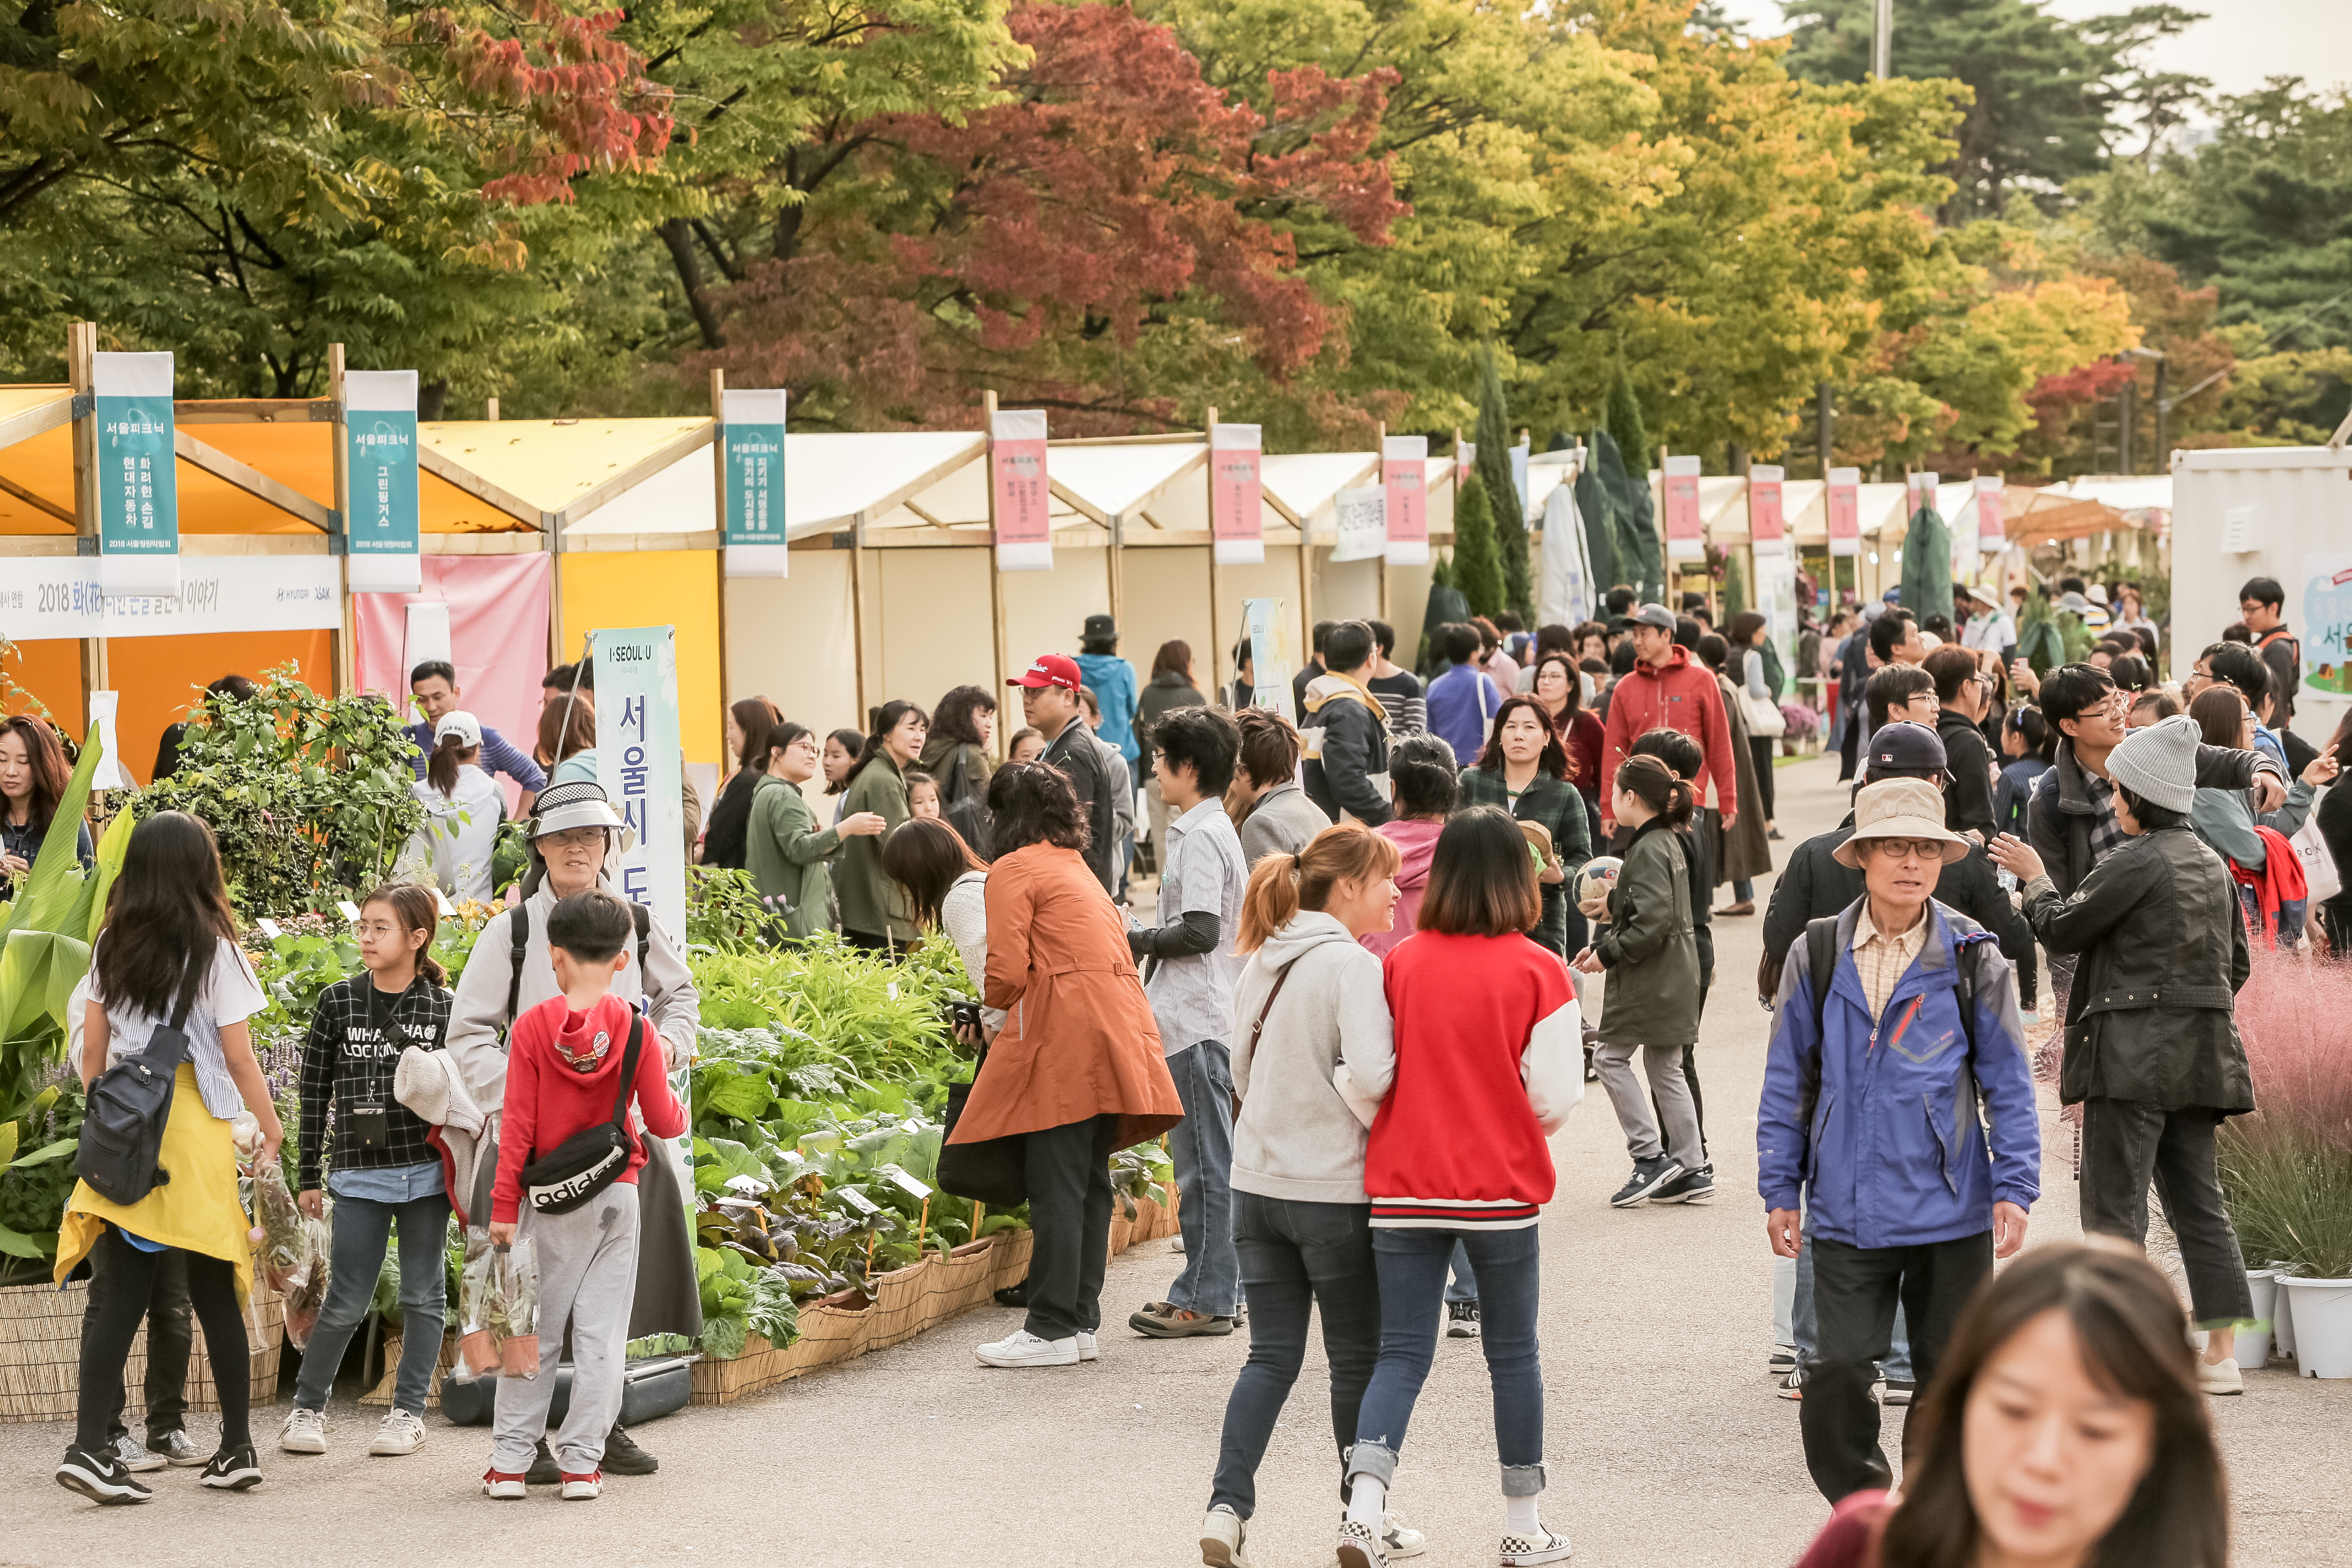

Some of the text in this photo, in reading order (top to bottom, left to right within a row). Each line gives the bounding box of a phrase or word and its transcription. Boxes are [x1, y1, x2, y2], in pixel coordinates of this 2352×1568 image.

[107, 421, 164, 435] 서울피크닉
[355, 434, 409, 445] 서울피크닉
[123, 456, 137, 526] 현대자동차
[140, 457, 153, 529] 화려한 손길
[377, 466, 390, 527] 그린핑거스
[109, 540, 125, 548] 2018
[11, 590, 23, 608] 연합
[38, 582, 70, 613] 2018
[187, 578, 219, 613] 이야기
[286, 590, 310, 600] HYUNDAI
[619, 694, 649, 846] 서울시
[535, 1153, 620, 1206] adidas
